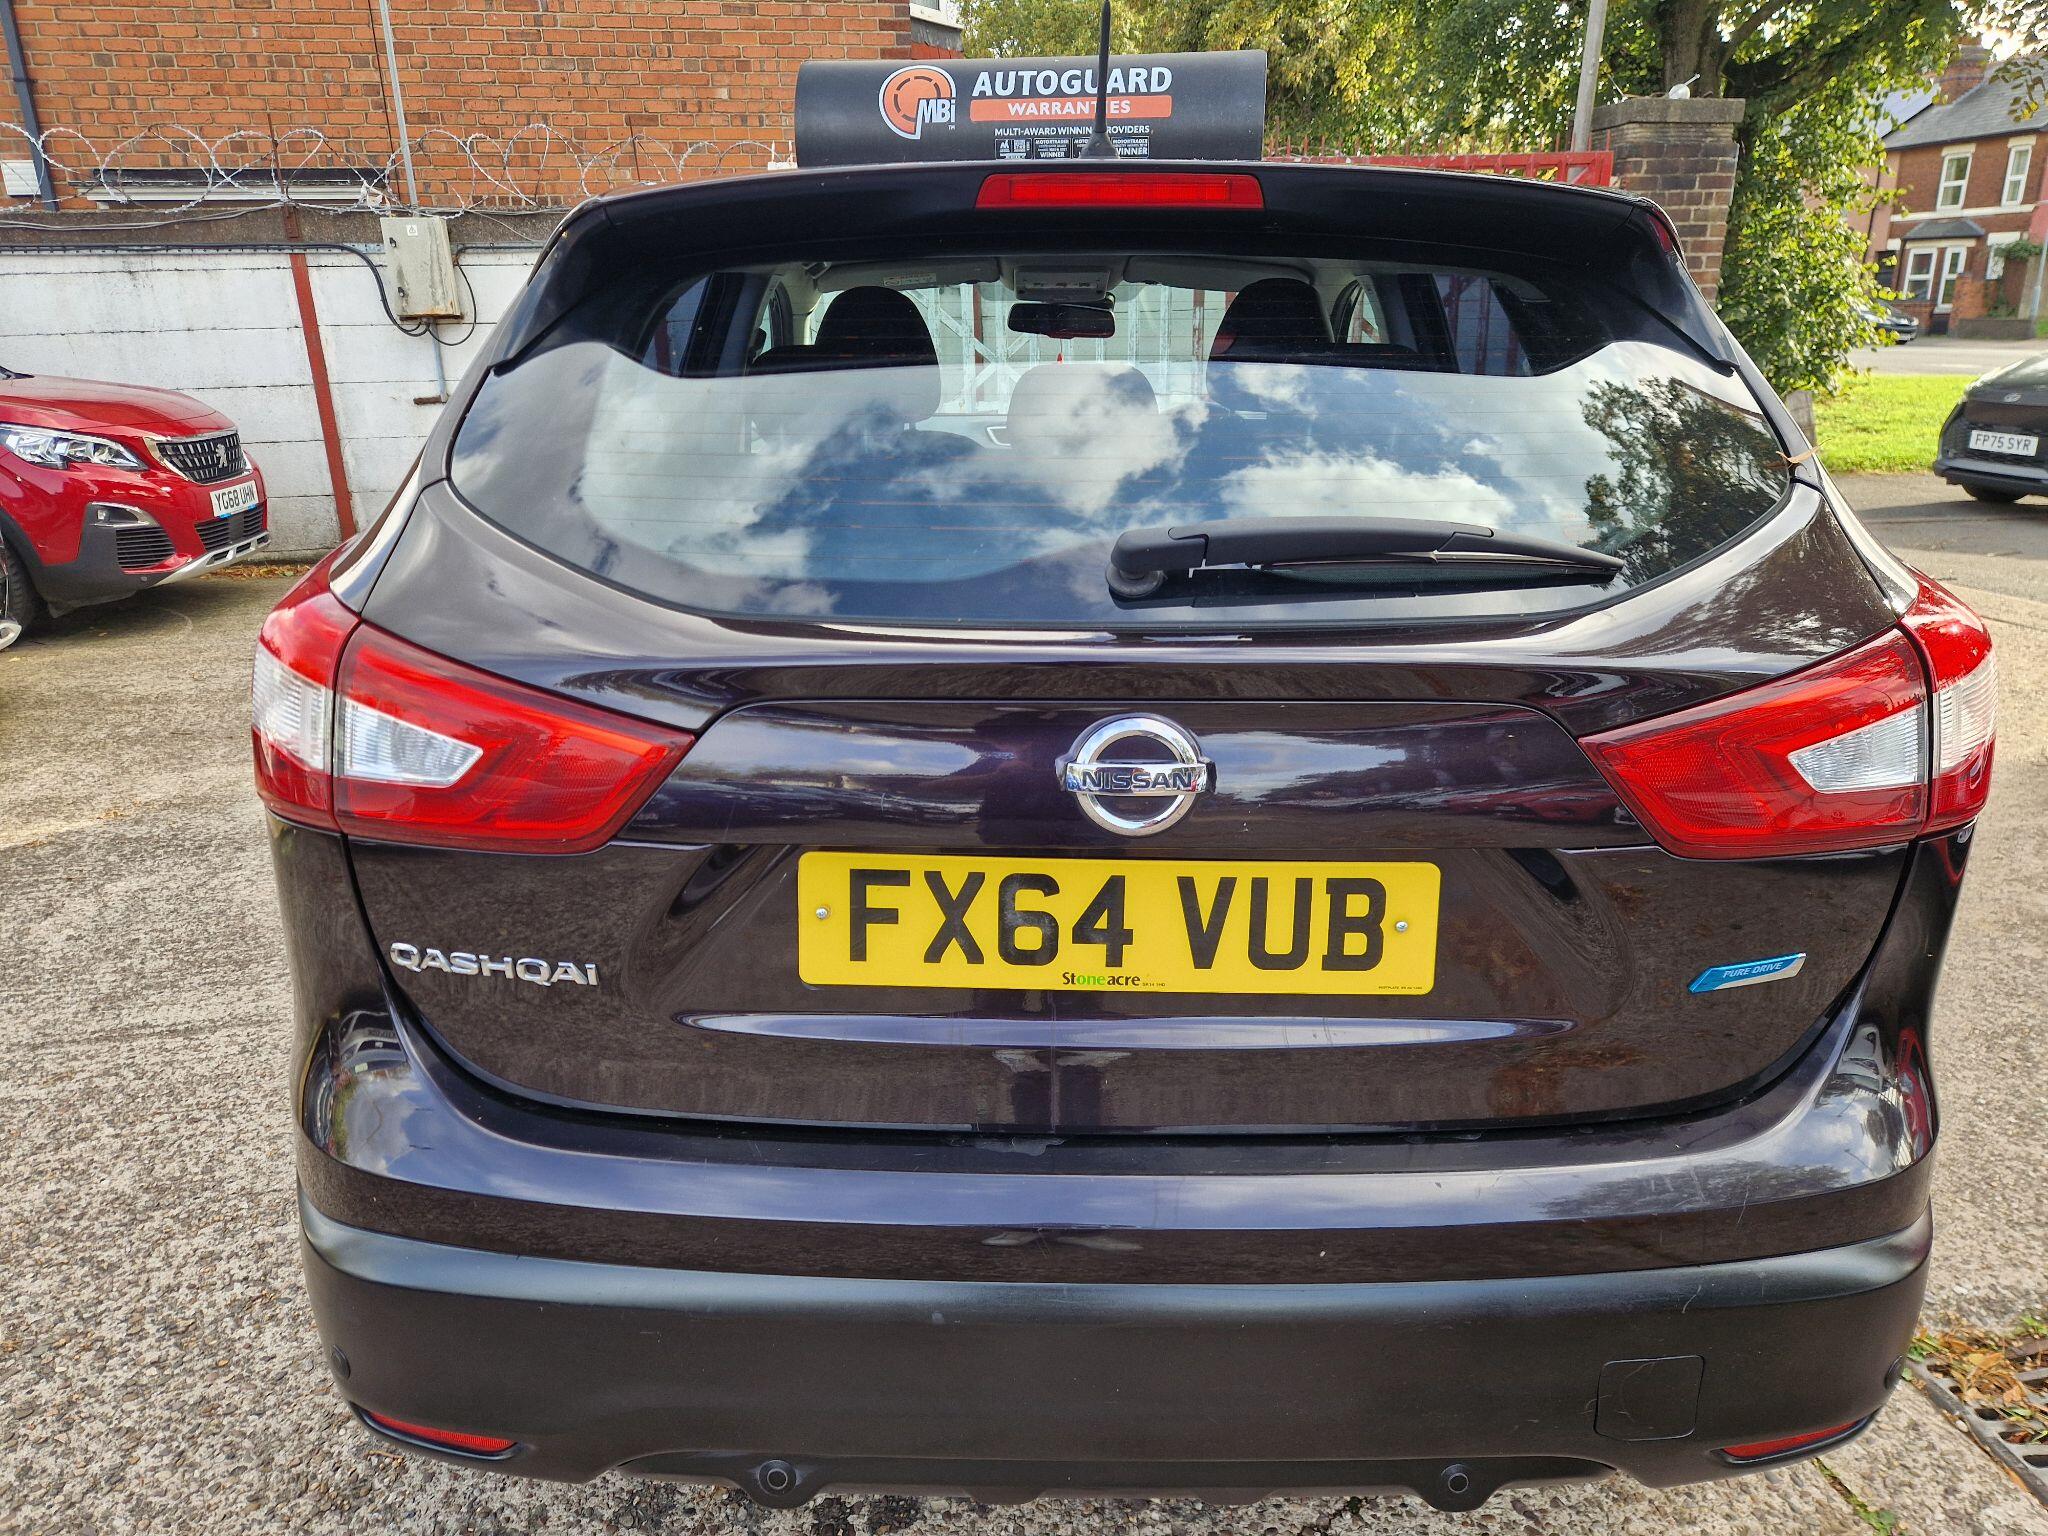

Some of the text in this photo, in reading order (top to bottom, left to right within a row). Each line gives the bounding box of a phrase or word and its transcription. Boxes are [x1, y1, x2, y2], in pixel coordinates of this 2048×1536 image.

[971, 66, 1173, 97] AUTOGUARD
[920, 98, 956, 123] MBi
[1007, 100, 1131, 117] WARRANTES
[1057, 126, 1093, 135] WINNIN
[1106, 125, 1150, 134] ROVIDERS
[1975, 433, 2031, 451] FP75 SYR
[214, 489, 240, 511] YG68
[1081, 770, 1193, 792] NISSAN
[849, 868, 1387, 972] FX64 VUB
[389, 942, 600, 986] QASHQAI
[1722, 961, 1784, 979] PURE DRIVE
[1062, 971, 1140, 986] Stoneacre
